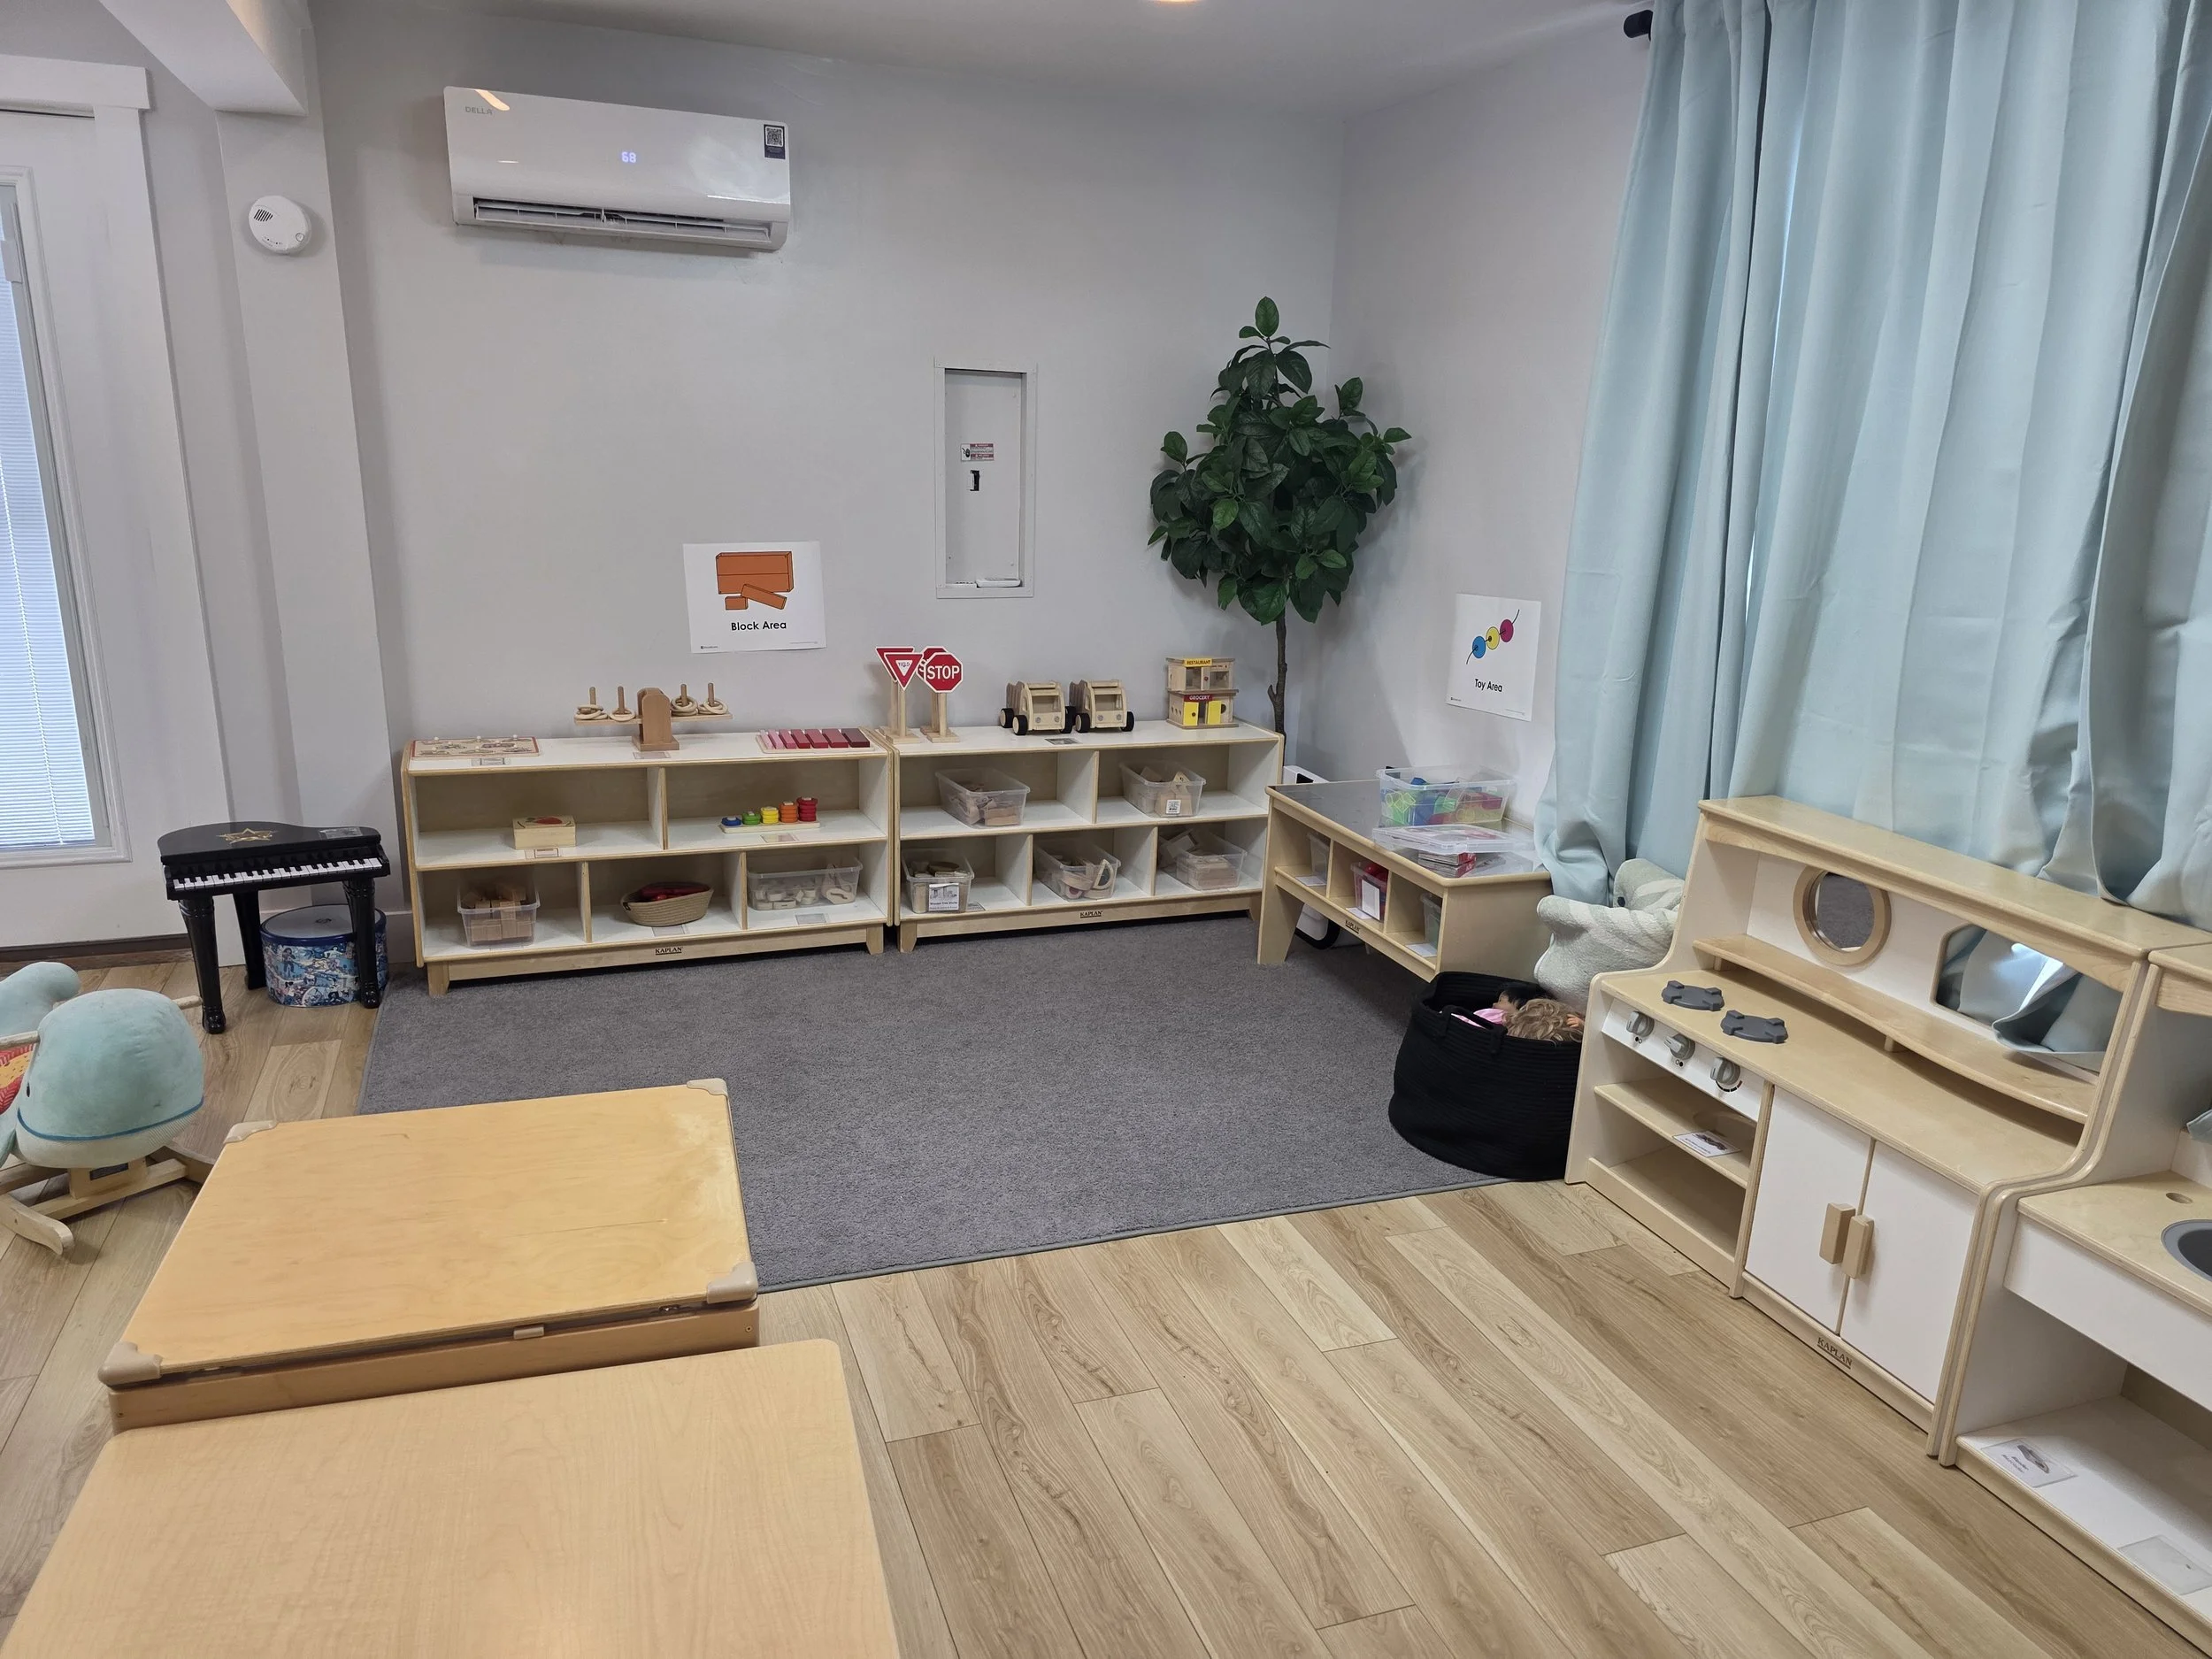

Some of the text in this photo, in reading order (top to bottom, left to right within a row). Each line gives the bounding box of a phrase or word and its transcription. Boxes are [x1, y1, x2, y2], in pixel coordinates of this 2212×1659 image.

[465, 106, 493, 116] DELLA
[622, 151, 636, 164] 68
[731, 620, 787, 631] Block Area
[926, 665, 960, 680] STOP
[1475, 679, 1502, 693] Toy Area
[1817, 1337, 1853, 1368] KAPLAN
